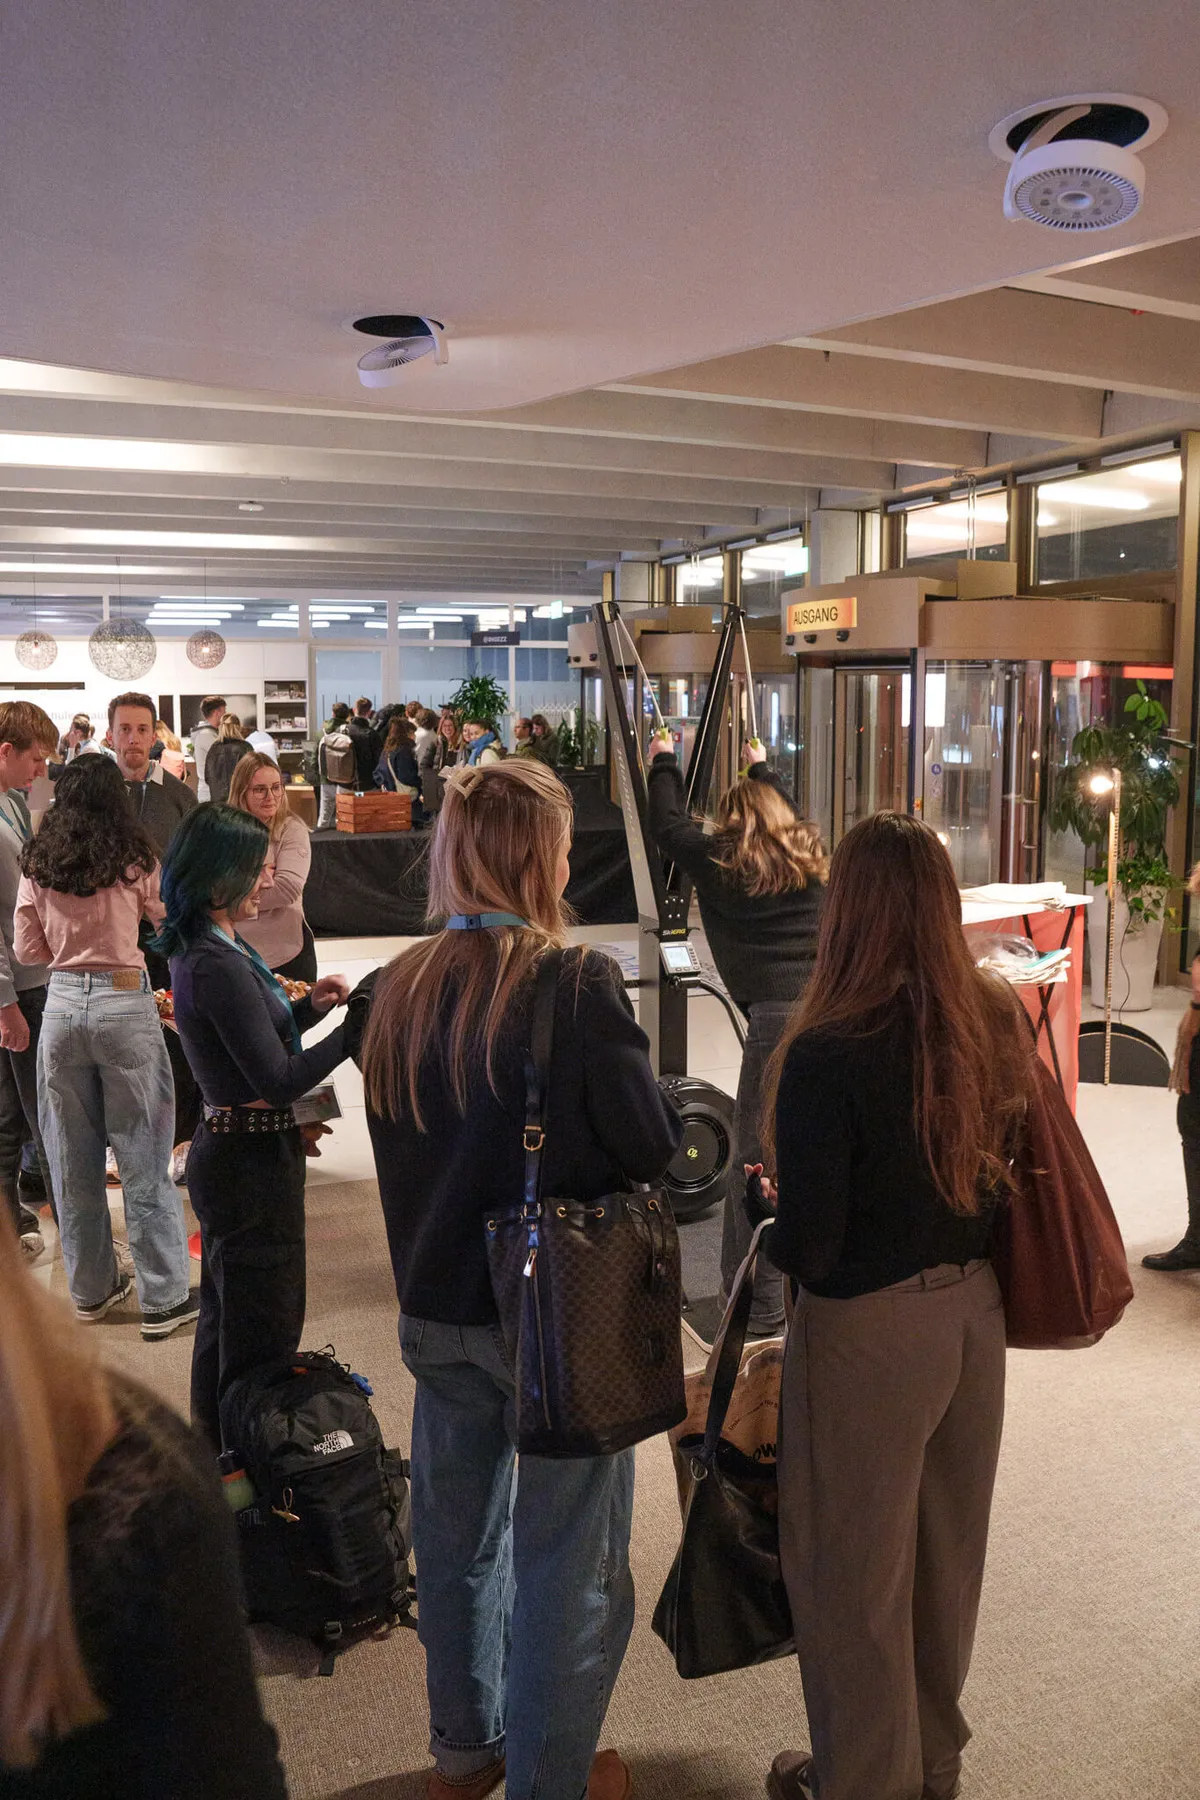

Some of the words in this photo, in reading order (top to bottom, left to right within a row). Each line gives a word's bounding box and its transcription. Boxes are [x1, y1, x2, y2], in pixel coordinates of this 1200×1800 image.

[794, 606, 838, 625] AUSGANG
[322, 1431, 338, 1442] THE
[313, 1438, 340, 1452] NORTH
[322, 1444, 342, 1456] FACE
